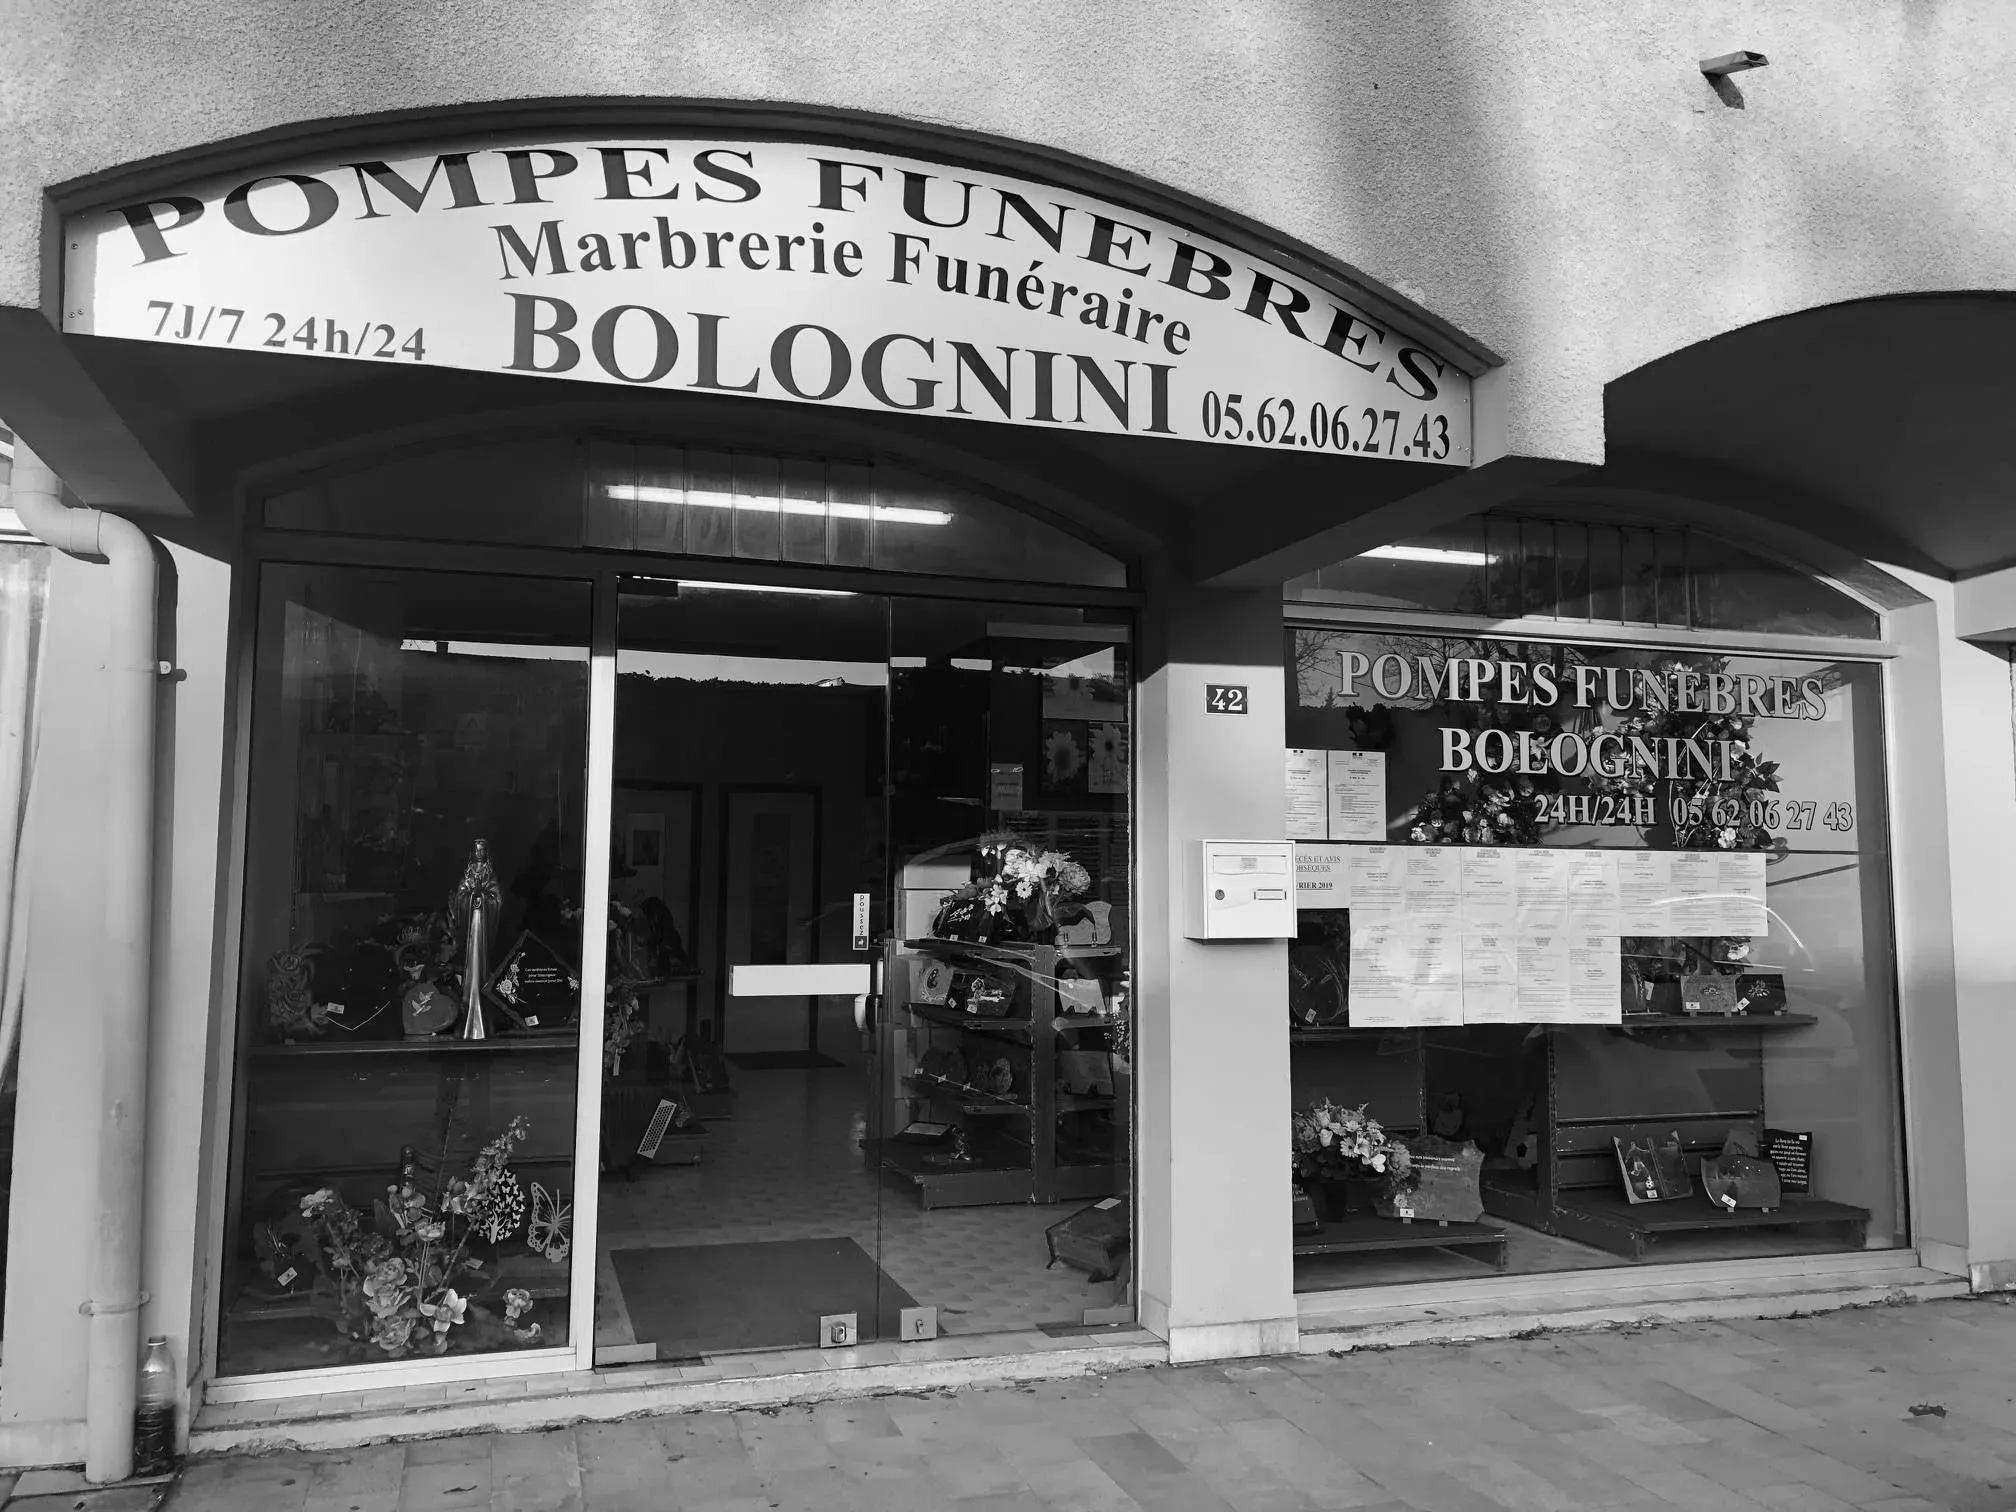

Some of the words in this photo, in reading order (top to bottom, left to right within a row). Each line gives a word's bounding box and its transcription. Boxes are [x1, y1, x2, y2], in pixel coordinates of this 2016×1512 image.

[111, 146, 761, 266] POMPES
[807, 156, 1447, 402] FUNEBRES
[489, 216, 863, 280] Marbrerie
[887, 231, 1192, 355] Funéraire
[147, 300, 244, 344] 7J/7
[263, 312, 426, 361] 24h/24
[502, 291, 1178, 435] BOLOGNINI
[1201, 390, 1450, 460] 05.62.06.27.43
[1212, 688, 1243, 711] 42
[1337, 650, 1558, 706] POMPES
[1438, 727, 1735, 781] BOLOGNINI
[1534, 794, 1657, 826] 24H/24H
[1674, 797, 1703, 826] 05
[1712, 798, 1741, 827] 62
[1750, 799, 1780, 829] 06
[1786, 801, 1816, 831] 27
[1823, 802, 1853, 832] 43
[1318, 882, 1333, 890] 2019
